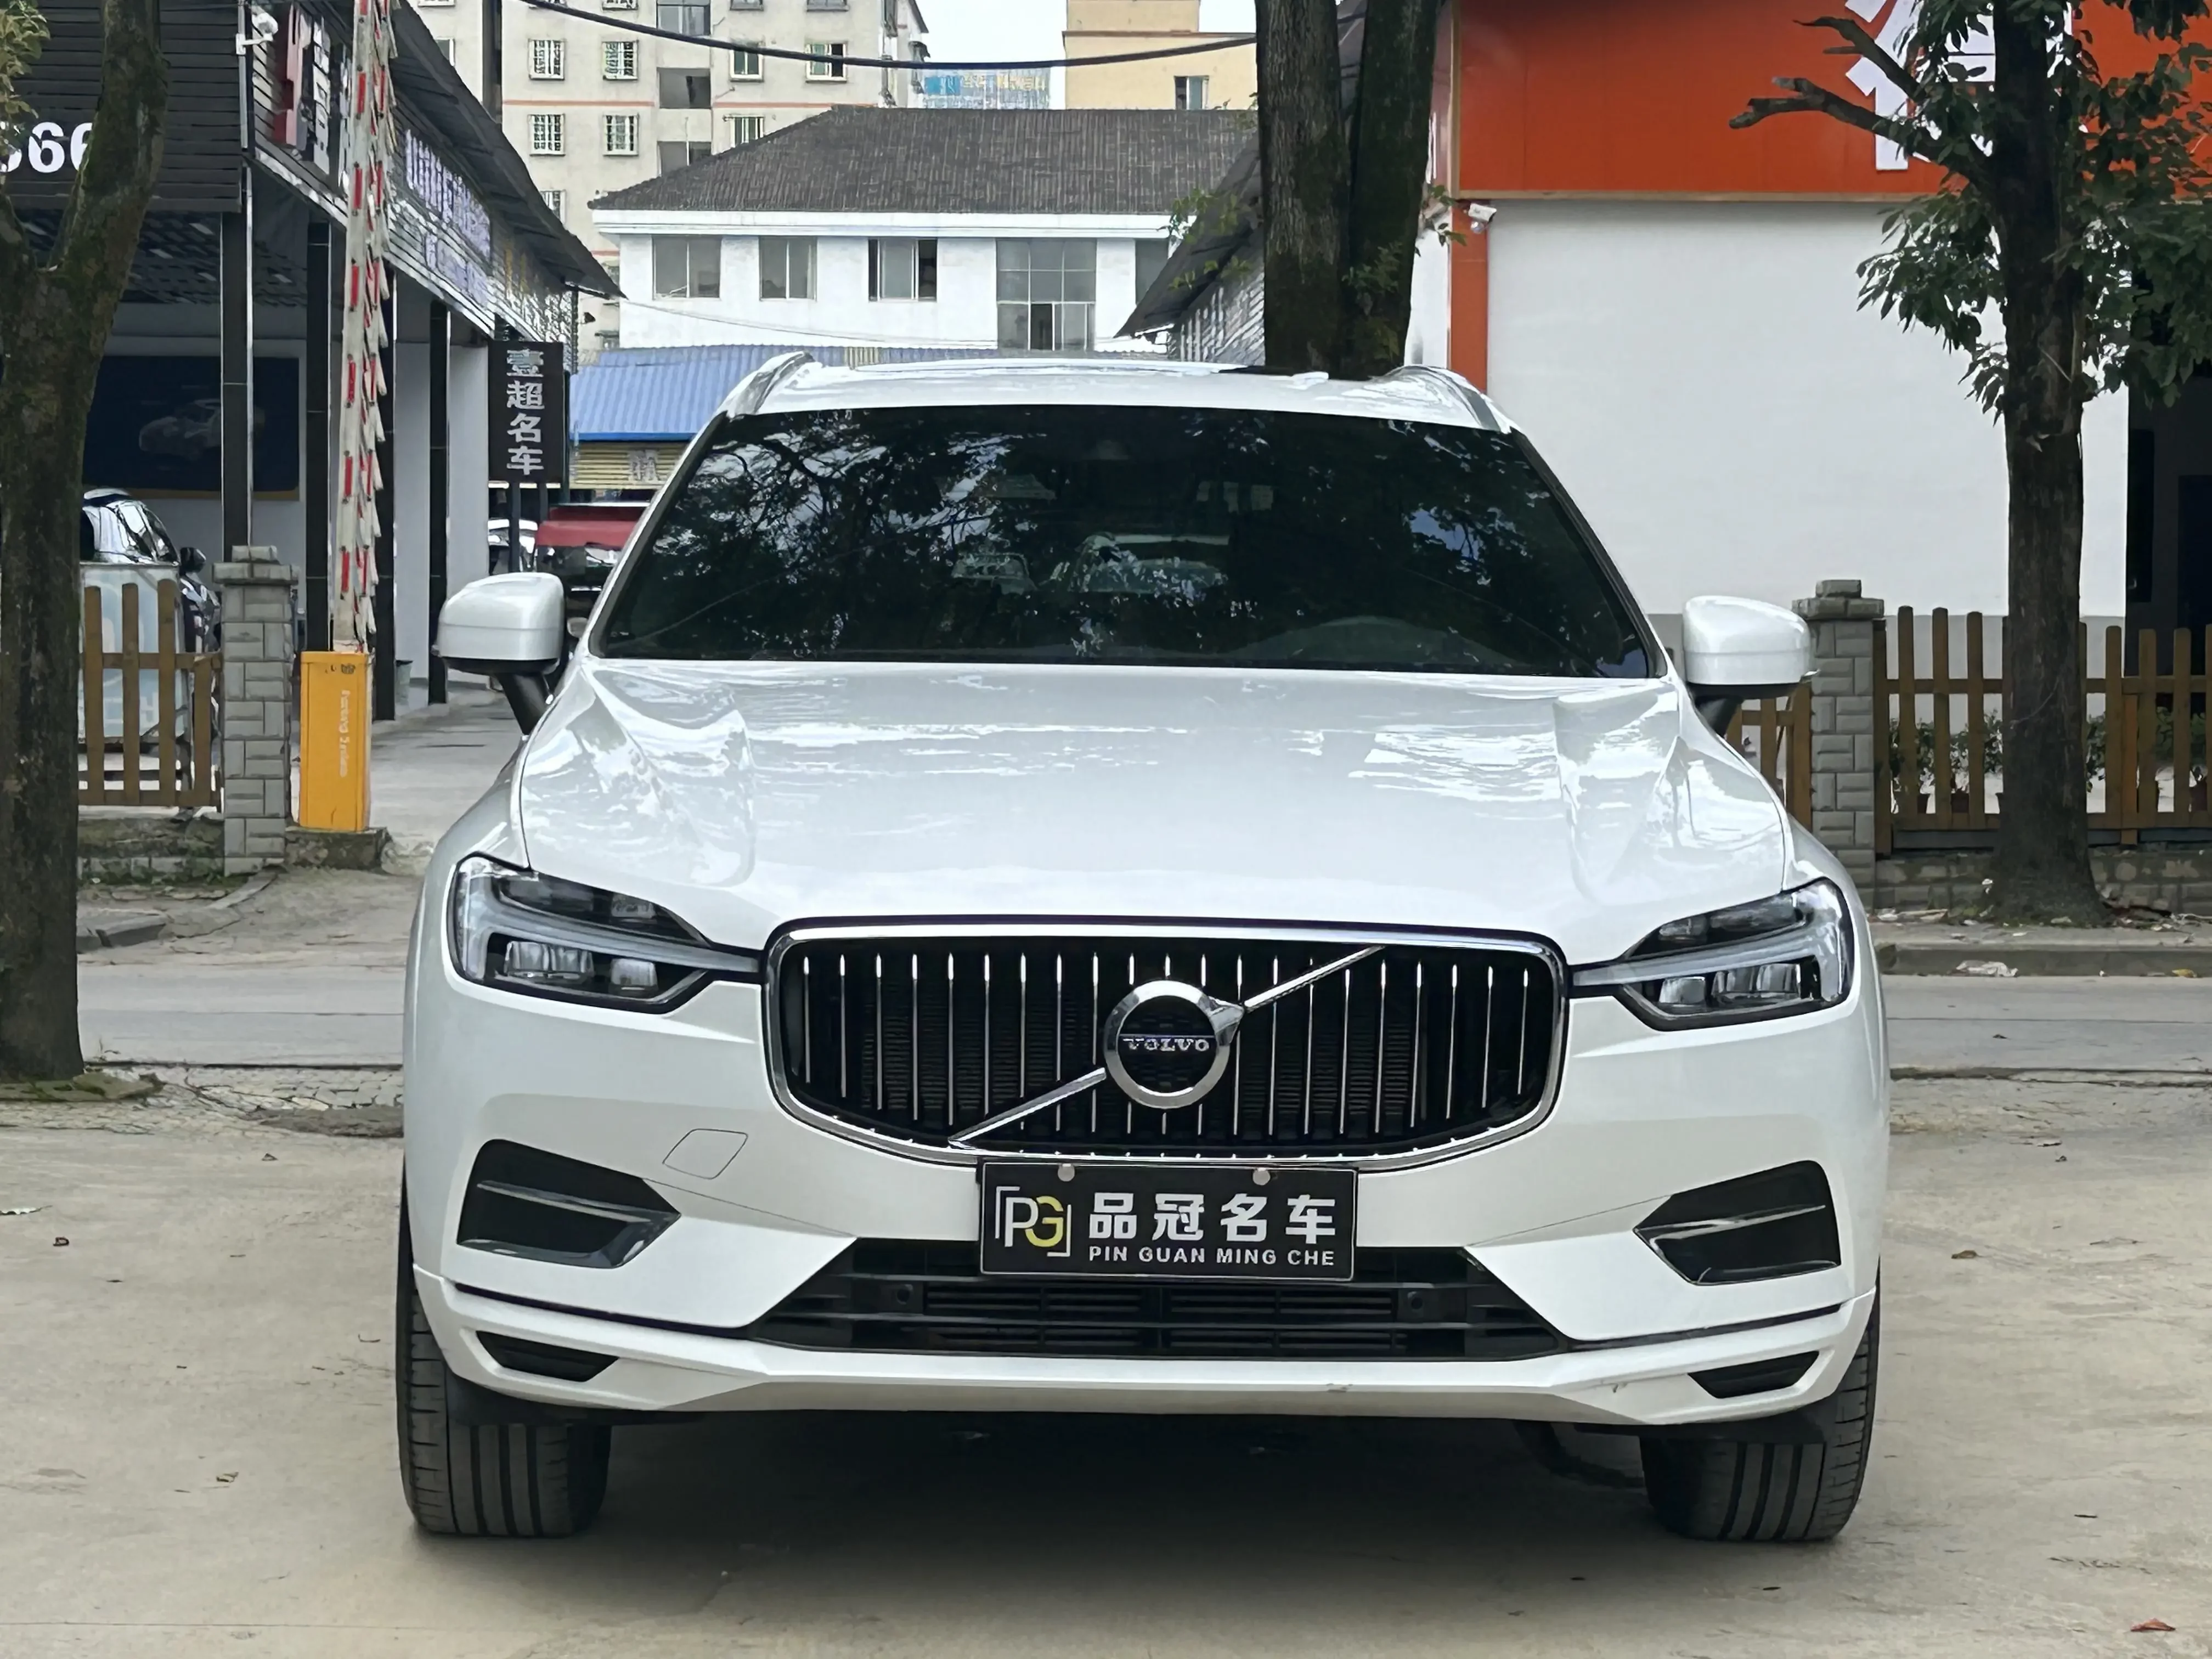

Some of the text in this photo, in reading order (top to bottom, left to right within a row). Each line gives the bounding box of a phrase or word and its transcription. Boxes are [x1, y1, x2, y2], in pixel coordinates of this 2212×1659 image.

[506, 348, 545, 476] 壹超名车
[1122, 1038, 1210, 1052] VOLVO
[1088, 1192, 1336, 1244] 品冠名车
[1089, 1246, 1335, 1265] PIN GUAN MING CHE
